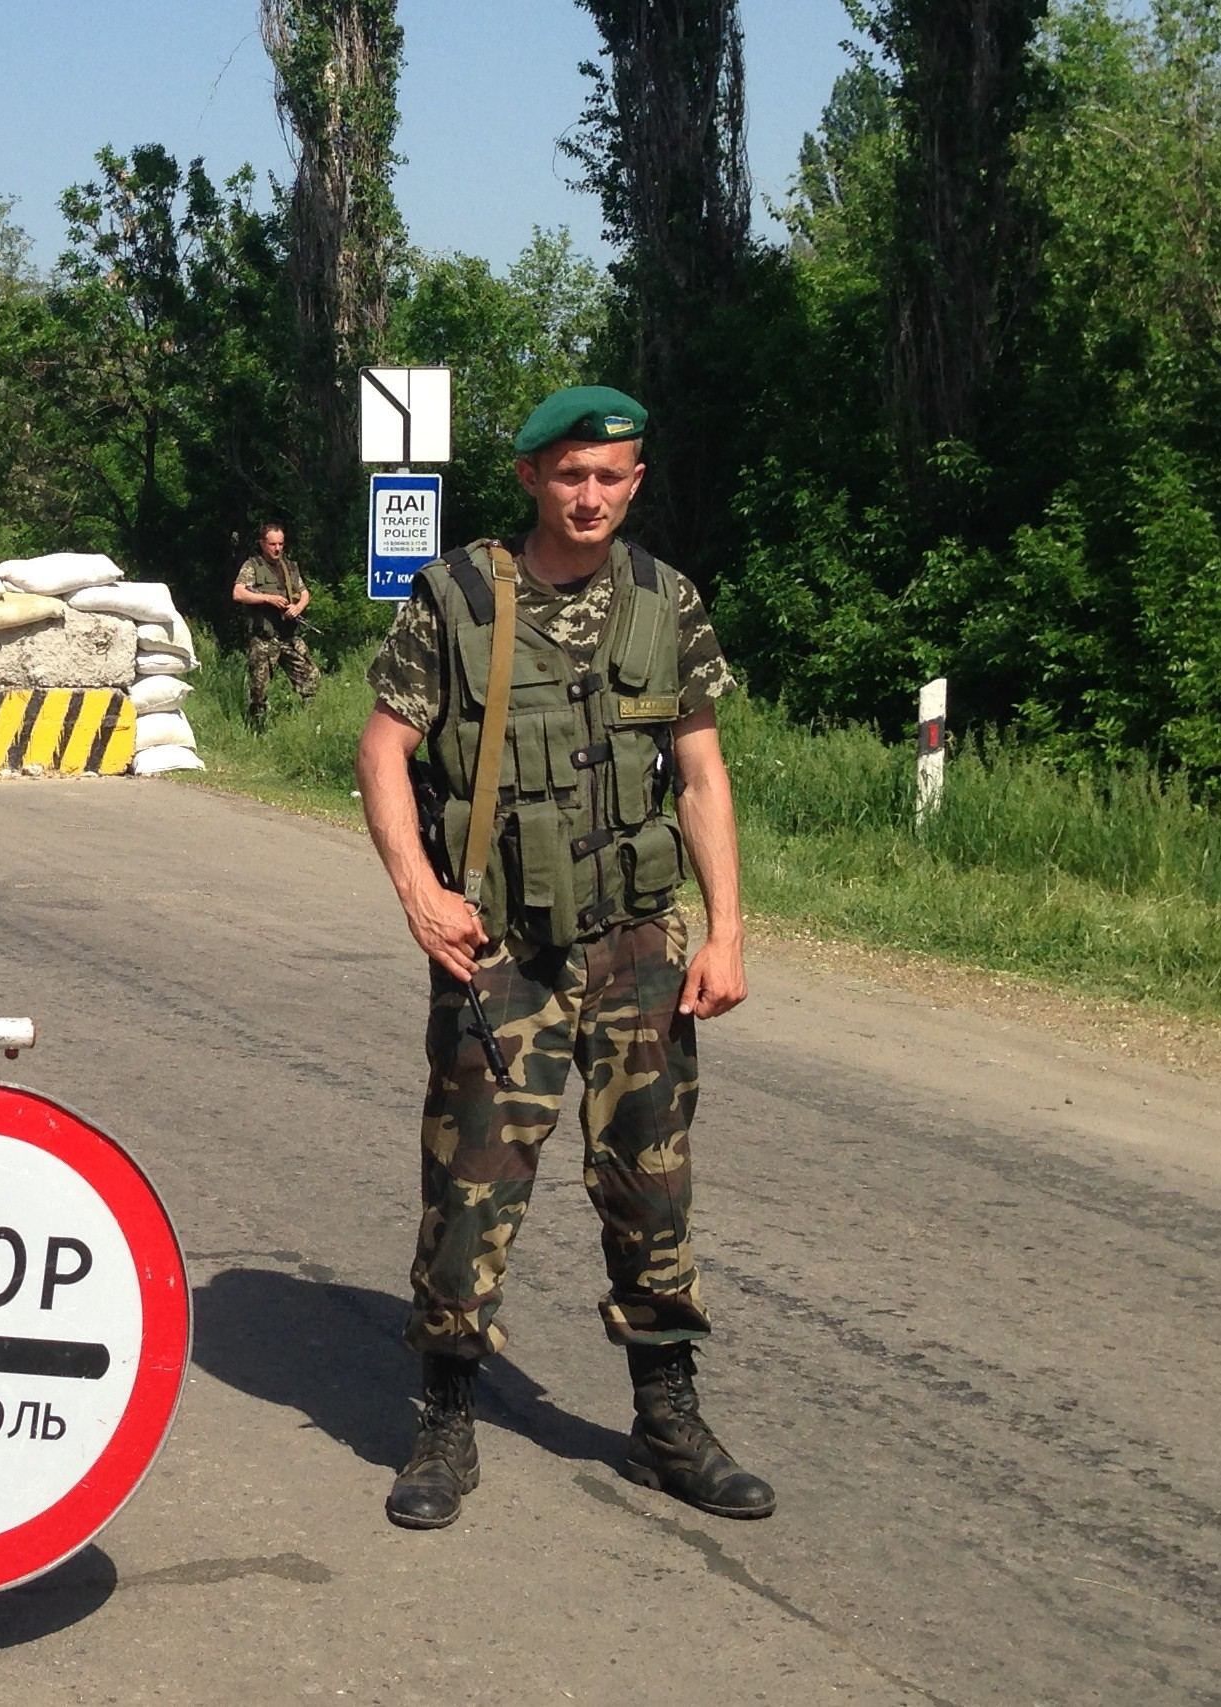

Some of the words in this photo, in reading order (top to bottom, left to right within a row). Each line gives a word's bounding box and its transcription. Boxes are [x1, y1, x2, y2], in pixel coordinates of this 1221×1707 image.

[386, 495, 425, 514] ДАІ
[381, 516, 430, 526] TRAFFIC
[384, 529, 427, 539] POLICE
[374, 570, 394, 586] 1,7
